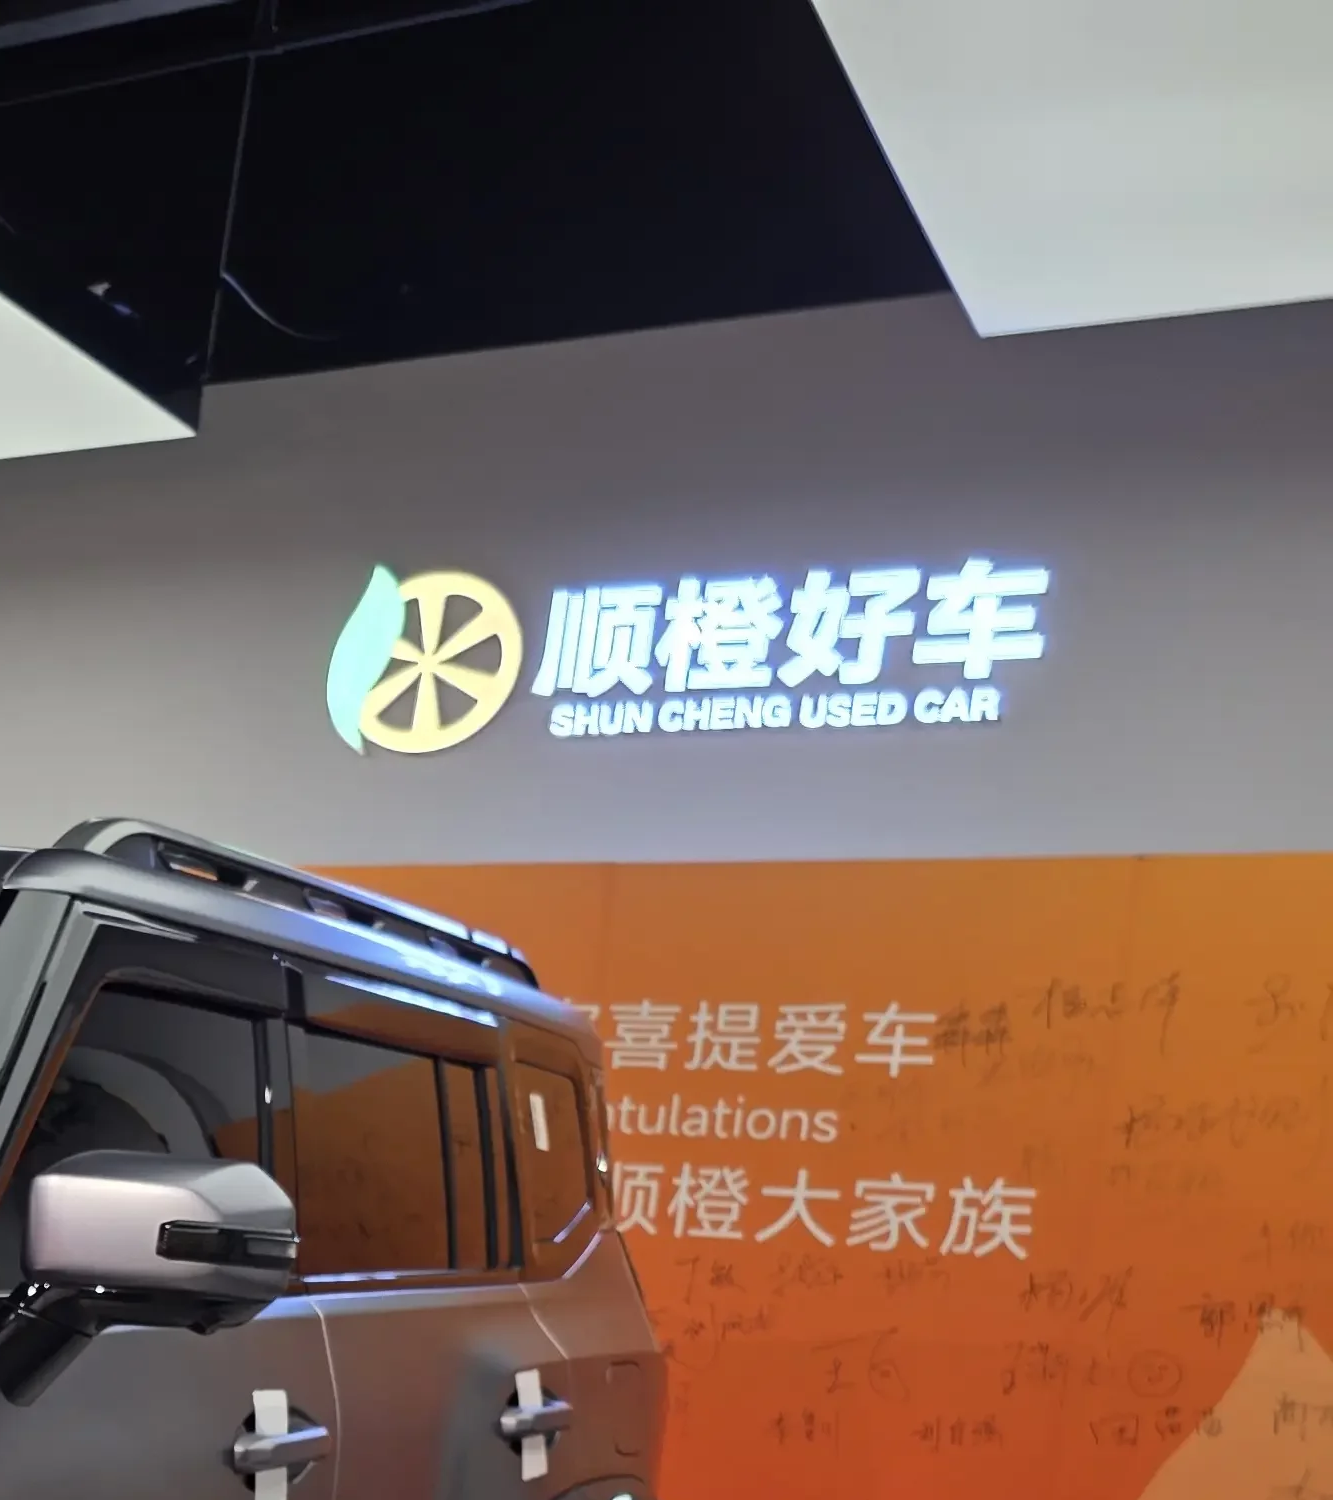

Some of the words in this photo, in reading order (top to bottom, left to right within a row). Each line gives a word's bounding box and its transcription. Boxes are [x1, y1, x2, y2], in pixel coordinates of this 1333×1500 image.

[532, 557, 1050, 698] 顺橙好车
[549, 701, 653, 737] SHUN
[658, 694, 793, 732] CHENG
[799, 691, 908, 729] USED
[913, 686, 1001, 722] CAR
[564, 997, 939, 1078] 喜提爱车
